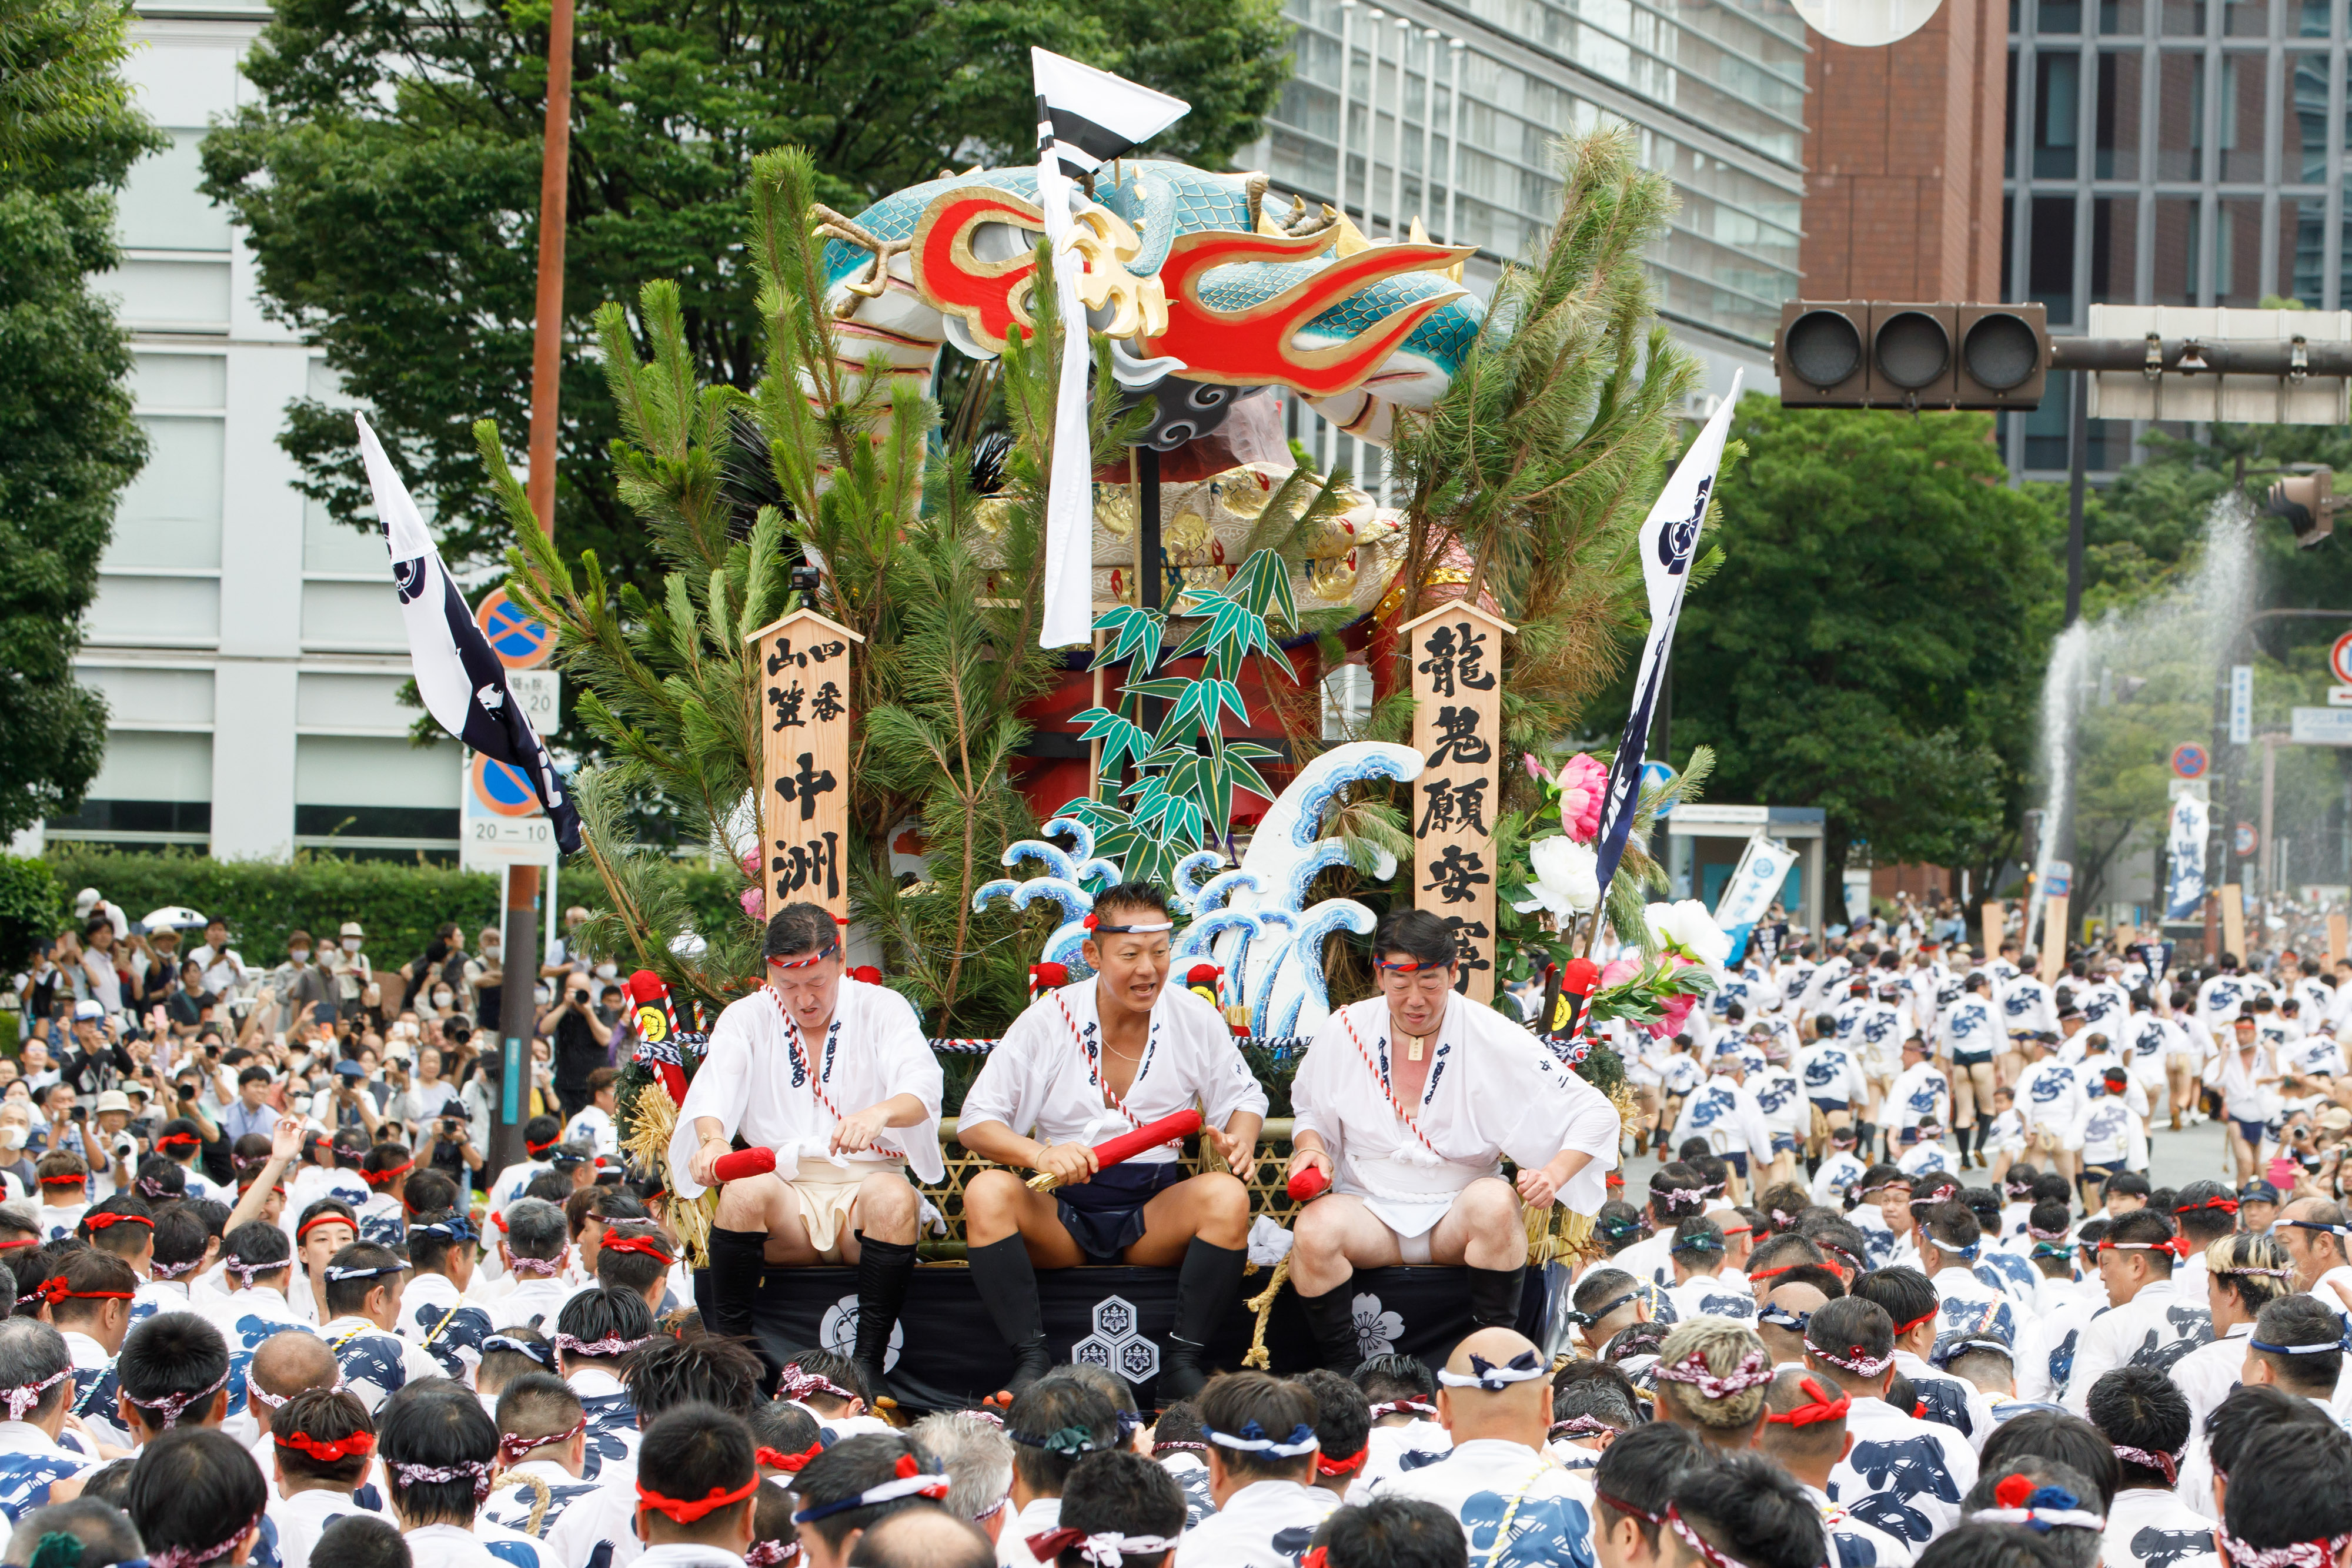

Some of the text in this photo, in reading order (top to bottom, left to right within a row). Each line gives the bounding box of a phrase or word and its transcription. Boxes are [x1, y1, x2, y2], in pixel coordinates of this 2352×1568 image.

[766, 637, 807, 733] 山笠
[808, 640, 847, 723] 四番
[771, 751, 839, 900] 中洲
